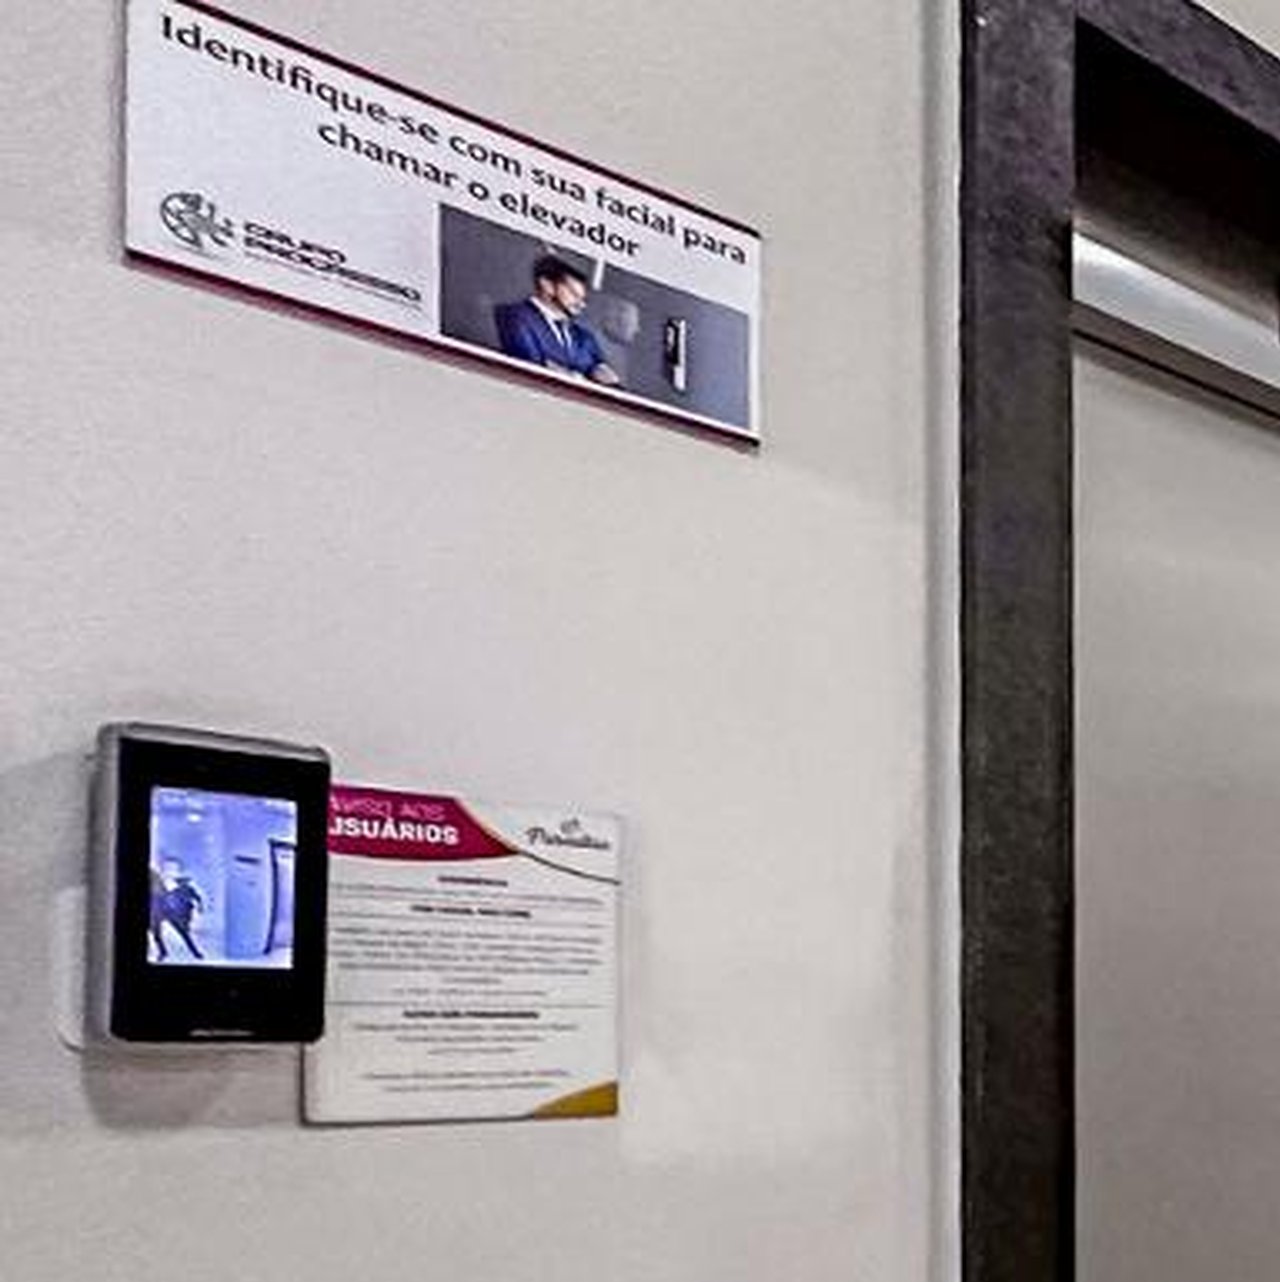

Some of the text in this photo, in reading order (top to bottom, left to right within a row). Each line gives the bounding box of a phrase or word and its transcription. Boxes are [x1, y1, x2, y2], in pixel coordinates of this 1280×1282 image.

[162, 14, 747, 266] Identifique-se com sua facial para
[317, 121, 641, 261] chamar o elevador
